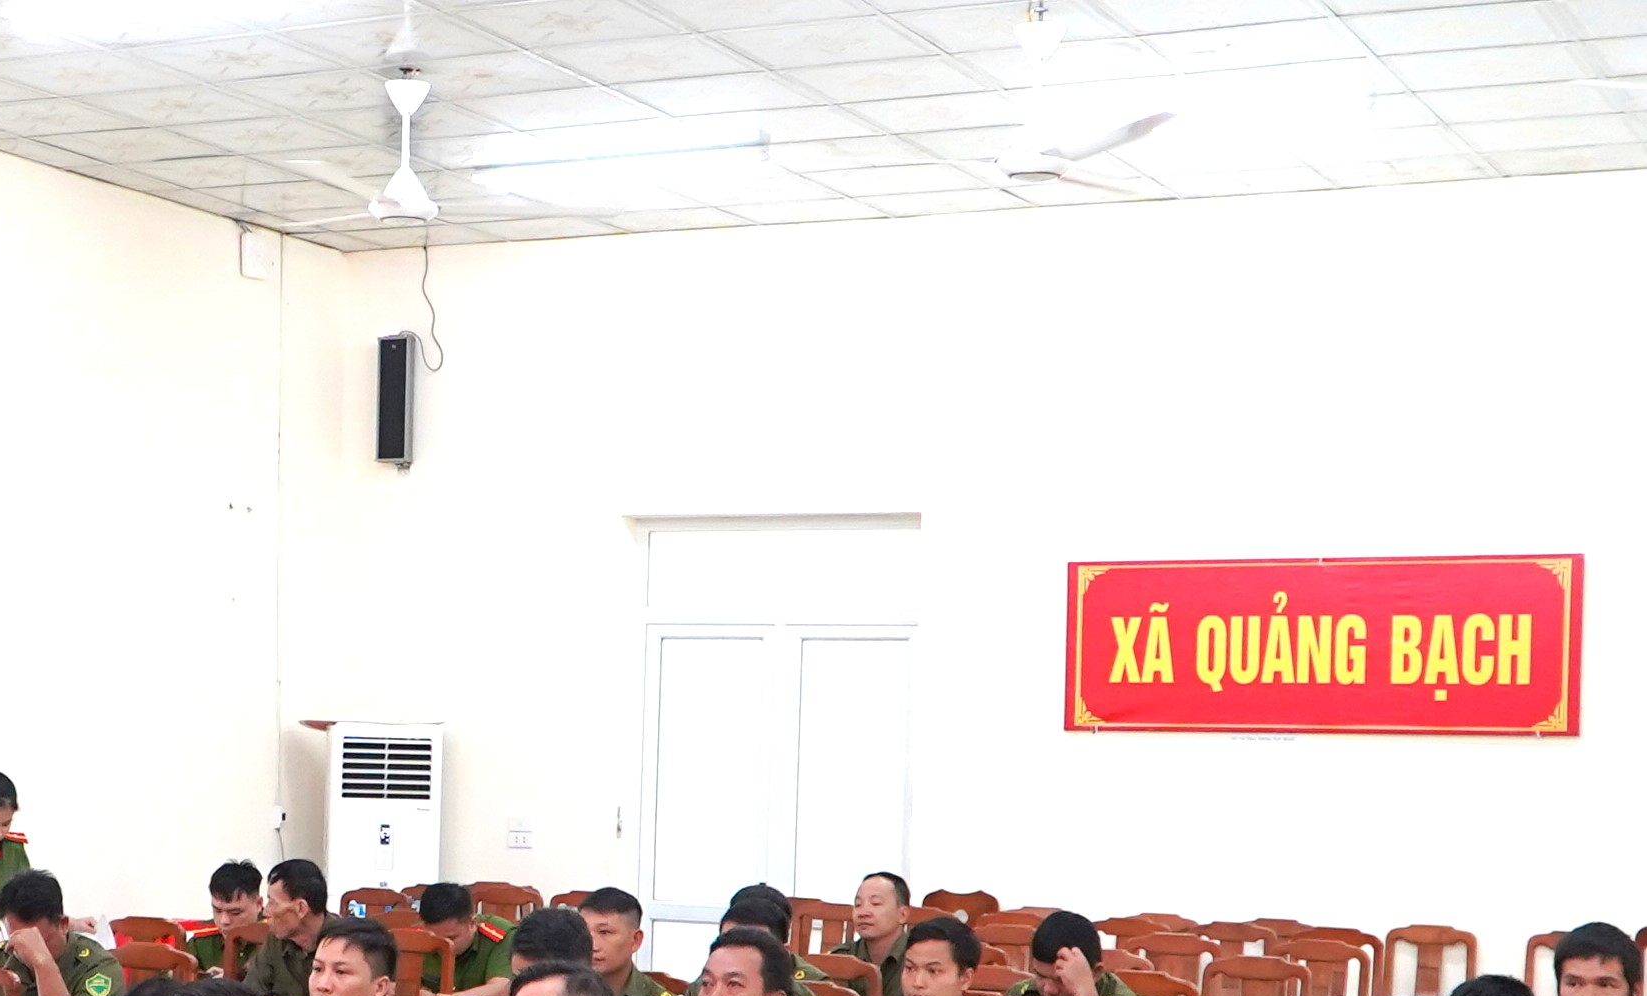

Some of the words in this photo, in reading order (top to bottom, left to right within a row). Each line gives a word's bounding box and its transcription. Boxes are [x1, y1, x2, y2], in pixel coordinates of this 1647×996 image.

[1109, 601, 1175, 684] XÃ
[1196, 590, 1367, 692] QUẢNG
[1390, 612, 1533, 701] BẠCH
